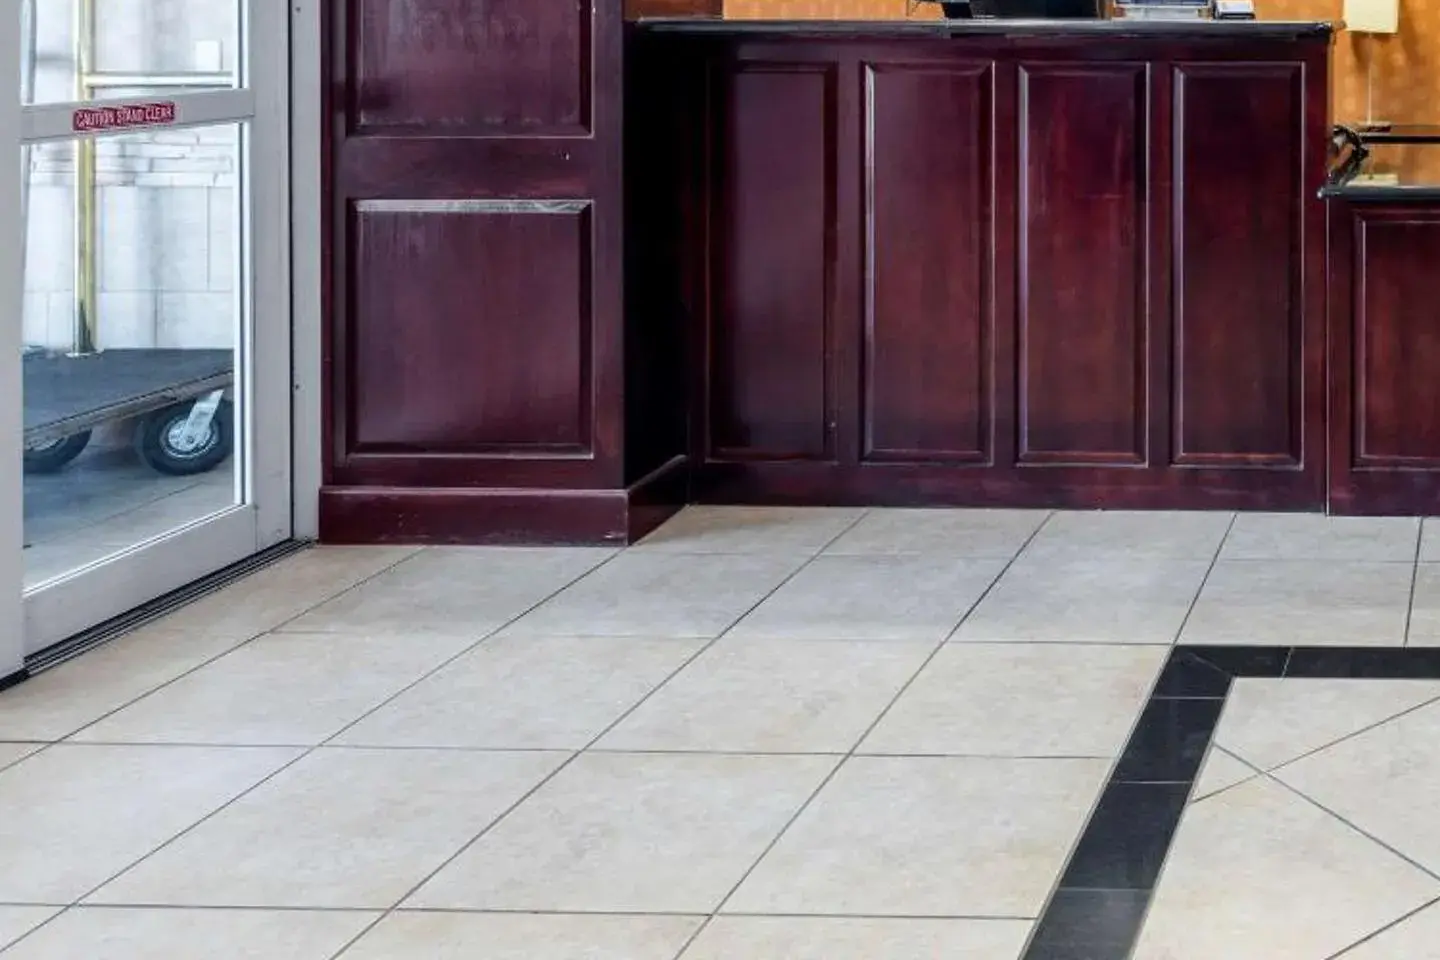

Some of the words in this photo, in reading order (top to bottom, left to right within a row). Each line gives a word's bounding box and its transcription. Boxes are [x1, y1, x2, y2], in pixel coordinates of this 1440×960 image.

[77, 109, 114, 127] CAUTION
[117, 107, 143, 124] STAND
[145, 105, 172, 121] CLEAR
